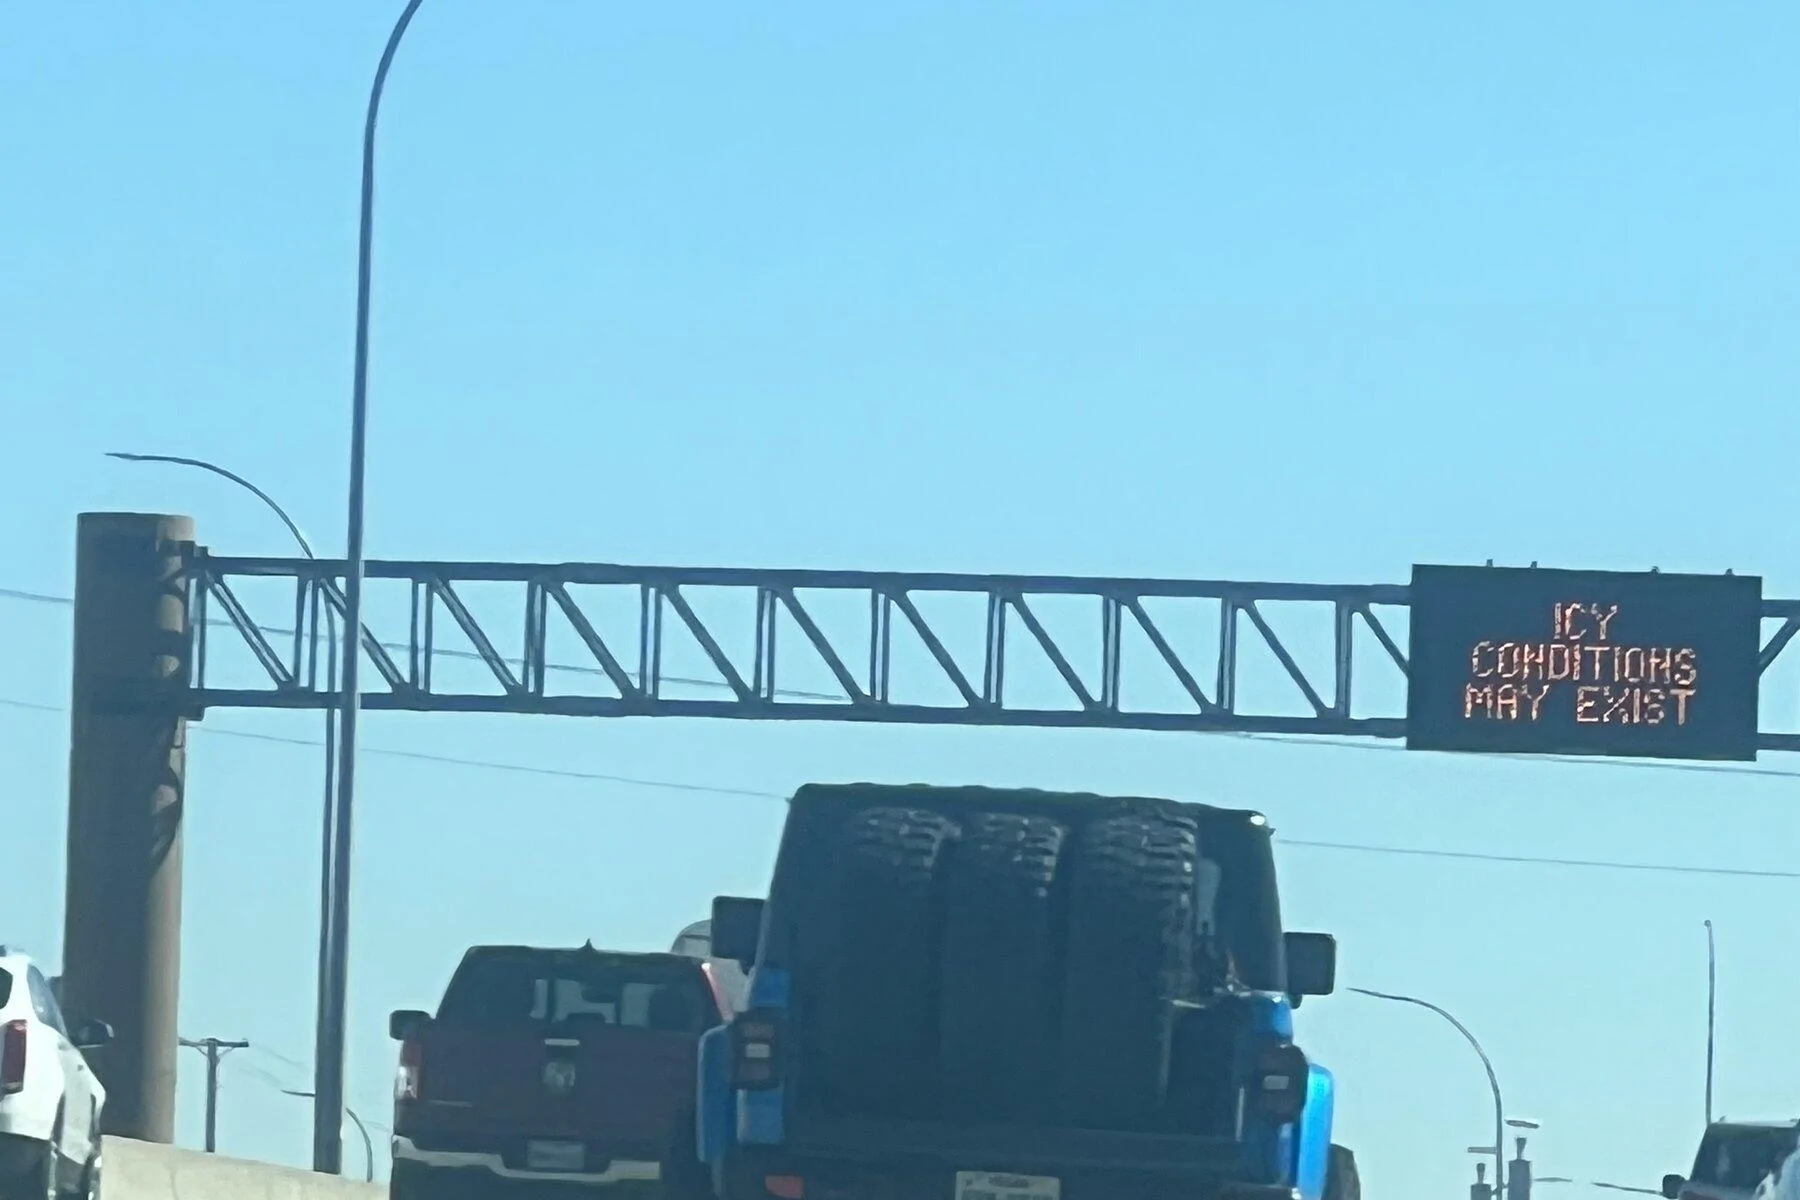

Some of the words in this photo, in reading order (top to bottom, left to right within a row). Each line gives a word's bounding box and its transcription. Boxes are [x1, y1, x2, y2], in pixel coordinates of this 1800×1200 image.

[1553, 602, 1618, 641] ICY
[1471, 640, 1698, 685] CONDITIONS
[1464, 683, 1550, 720] MAY
[1576, 685, 1697, 725] EXIST
